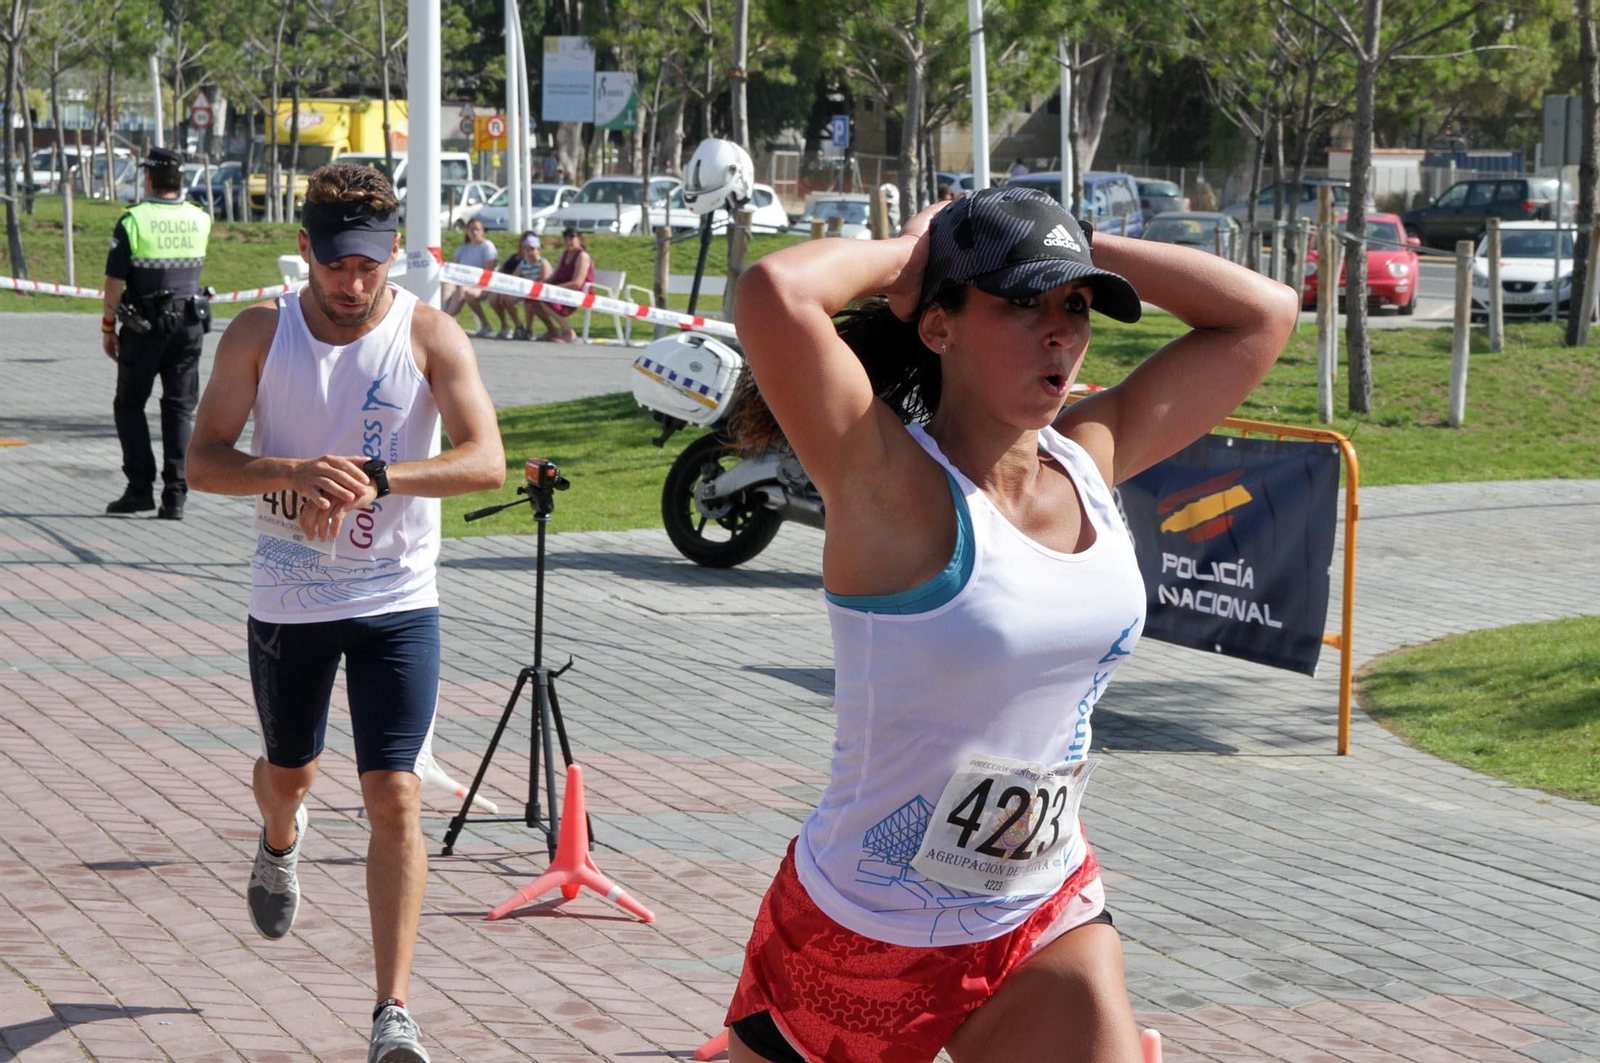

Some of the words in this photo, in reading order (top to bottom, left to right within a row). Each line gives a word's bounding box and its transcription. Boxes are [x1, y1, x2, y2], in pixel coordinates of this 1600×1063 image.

[157, 236, 195, 249] LOCAL
[1043, 238, 1081, 252] adidas
[1162, 552, 1254, 590] POLICÍA
[1158, 584, 1283, 629] NACIONAL
[946, 777, 1068, 860] 4223
[925, 848, 1004, 876] AGRUPACIÓN
[983, 879, 1004, 891] 4223
